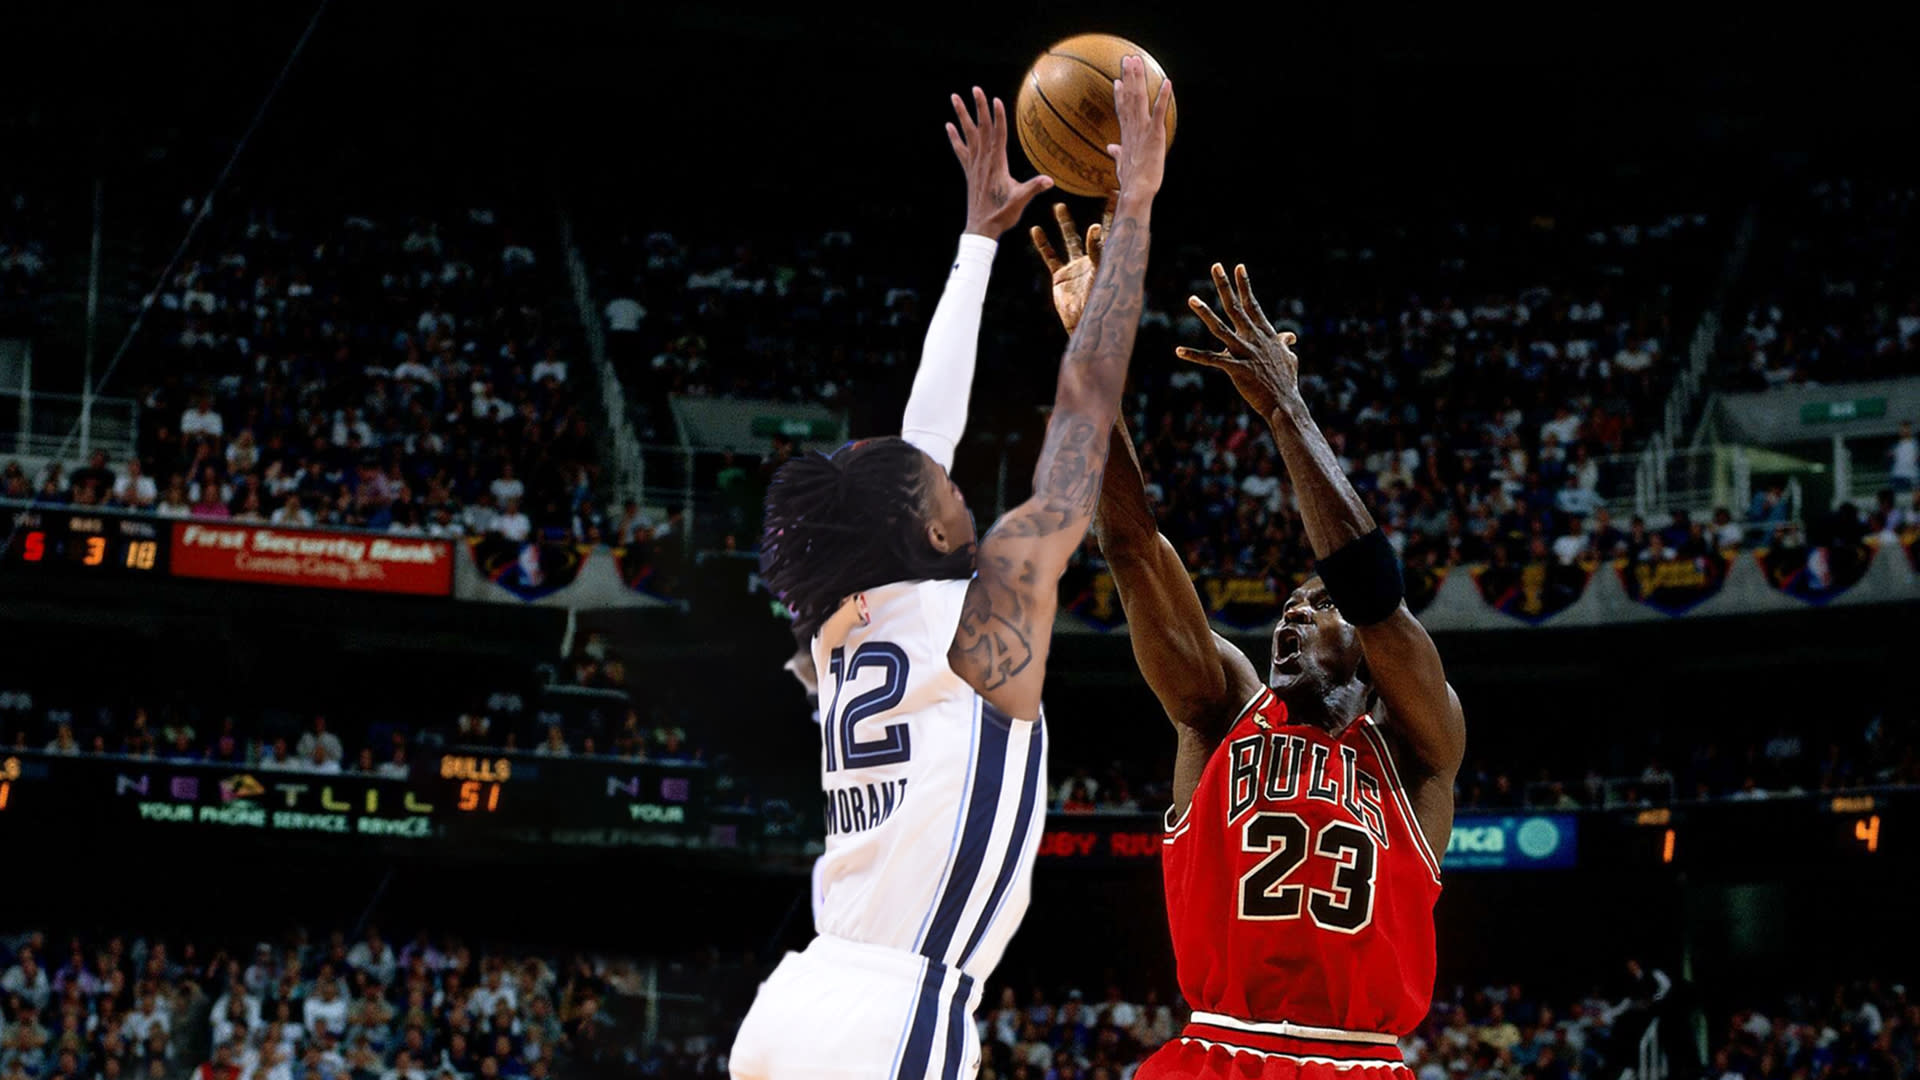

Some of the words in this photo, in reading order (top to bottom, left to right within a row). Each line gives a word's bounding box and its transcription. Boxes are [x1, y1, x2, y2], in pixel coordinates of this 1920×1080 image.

[82, 536, 107, 567] 3
[183, 525, 246, 549] First
[250, 531, 365, 562] Security
[368, 539, 435, 563] Bank
[825, 641, 910, 772] 12
[440, 753, 511, 782] BULLS
[457, 781, 501, 812] 51
[823, 778, 907, 836] MORANT
[1227, 733, 1389, 849] BULLS
[138, 801, 194, 822] YOUR
[272, 812, 349, 833] SERVICE
[628, 803, 686, 823] YOUR
[1662, 828, 1676, 863] 1
[1855, 814, 1881, 853] 4
[1237, 811, 1378, 935] 23
